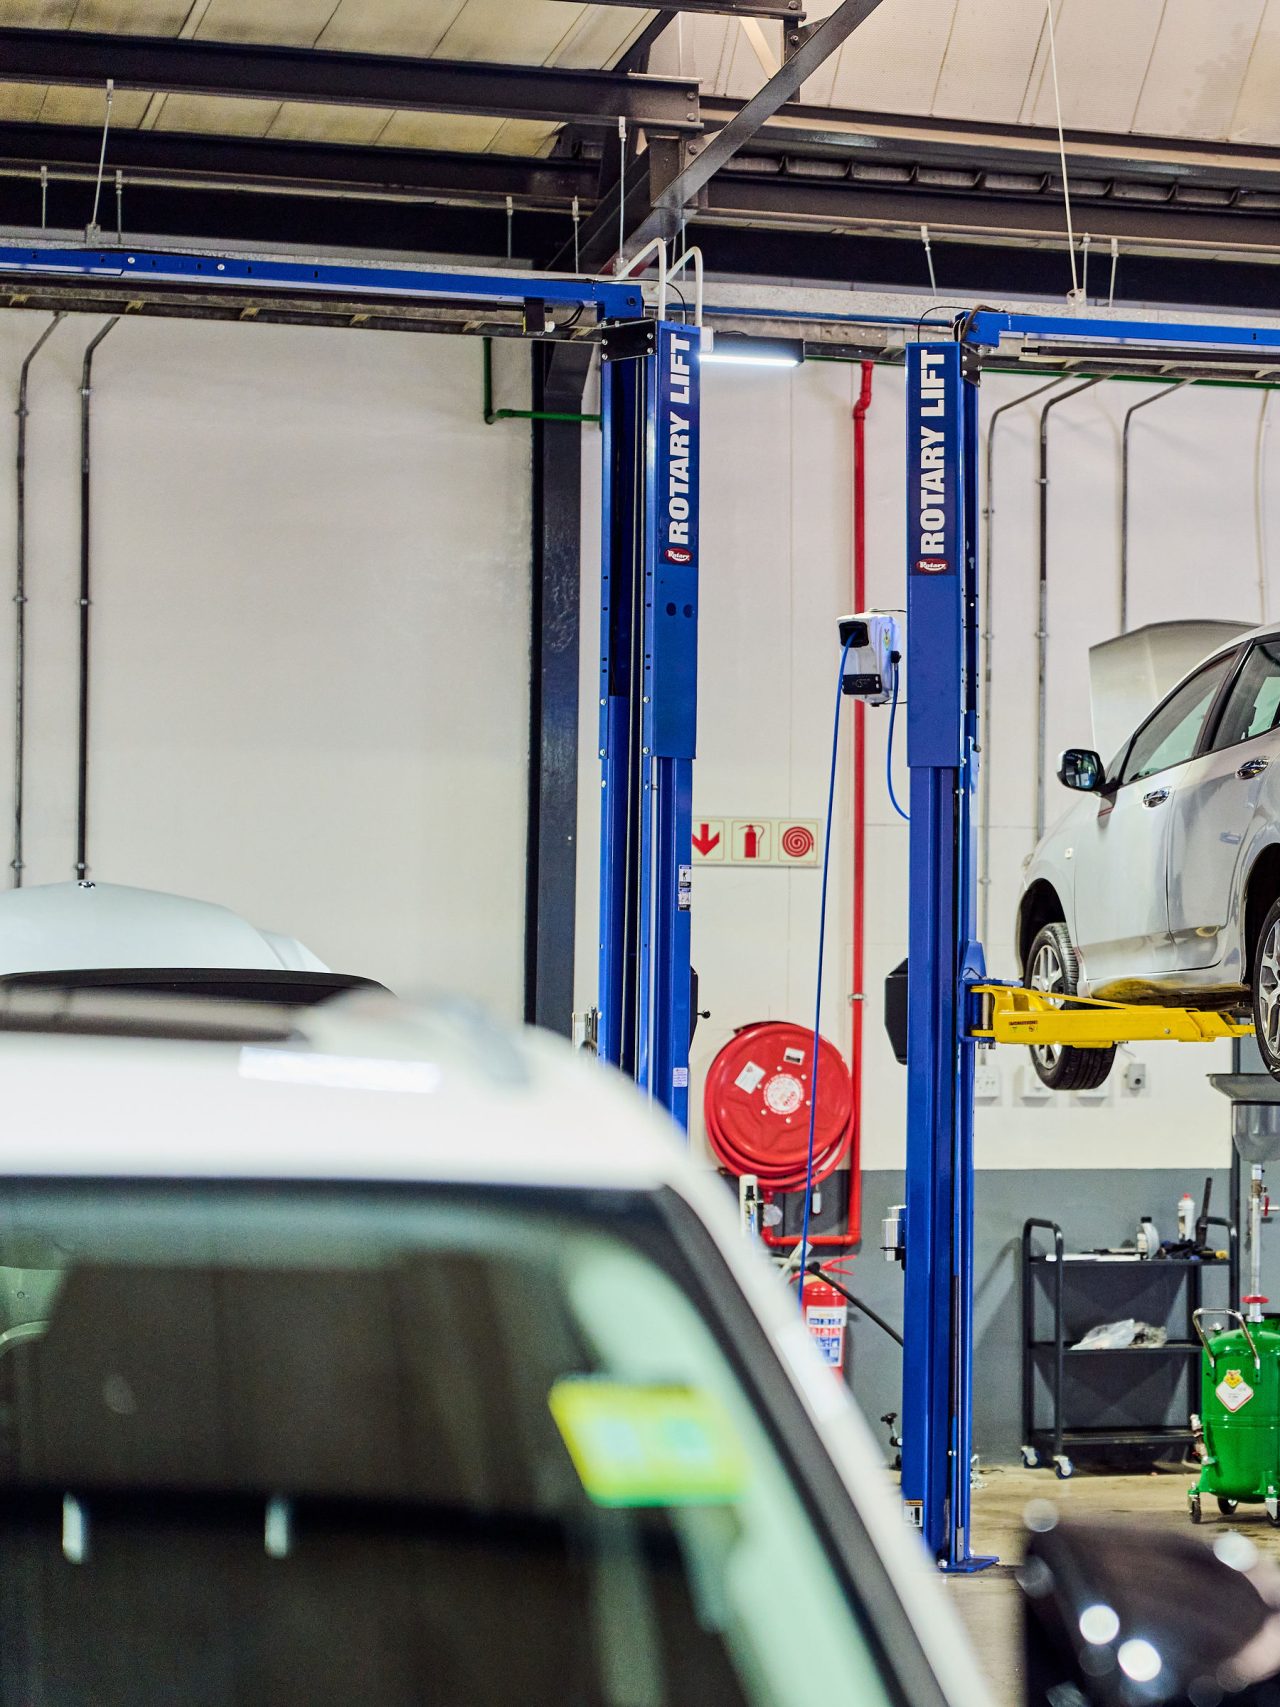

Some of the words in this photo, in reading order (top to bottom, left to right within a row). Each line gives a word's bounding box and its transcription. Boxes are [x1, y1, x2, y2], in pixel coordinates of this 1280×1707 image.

[670, 333, 690, 404] LIFT
[921, 349, 945, 417] LIFT
[669, 411, 690, 545] ROTARY
[920, 426, 945, 555] ROTARY
[918, 561, 947, 571] Rotary
